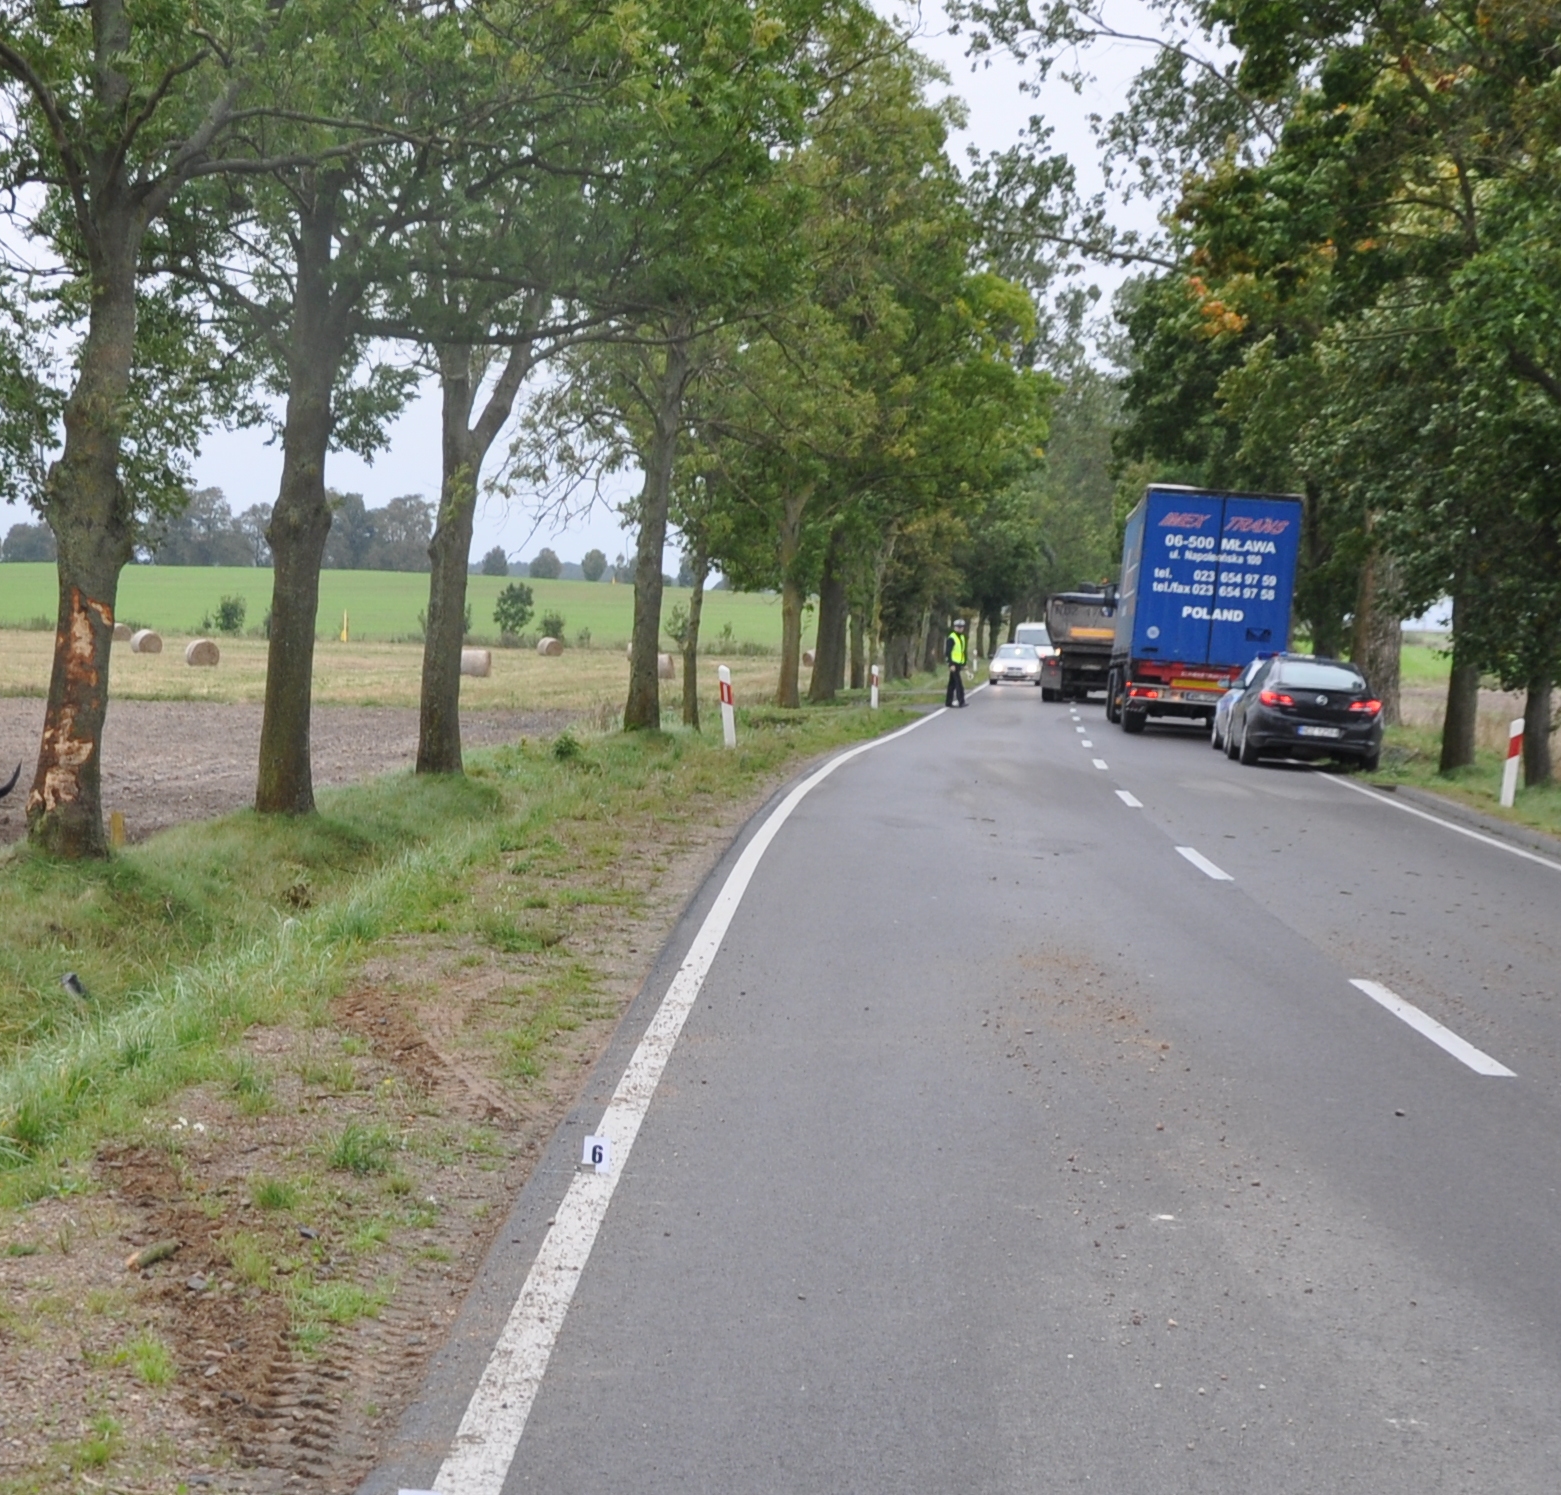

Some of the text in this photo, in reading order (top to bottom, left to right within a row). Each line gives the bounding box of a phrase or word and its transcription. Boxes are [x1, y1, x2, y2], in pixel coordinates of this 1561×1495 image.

[1158, 512, 1212, 529] IMEX
[1165, 534, 1277, 554] 06-500 MŁAWA
[1169, 550, 1180, 560] ul.
[1154, 567, 1277, 587] tel. 023 654 97 59
[1192, 584, 1214, 597] 023
[1218, 585, 1241, 598] 654
[1243, 587, 1258, 600] 97
[1182, 605, 1244, 622] POLAND
[591, 1144, 604, 1164] 6
